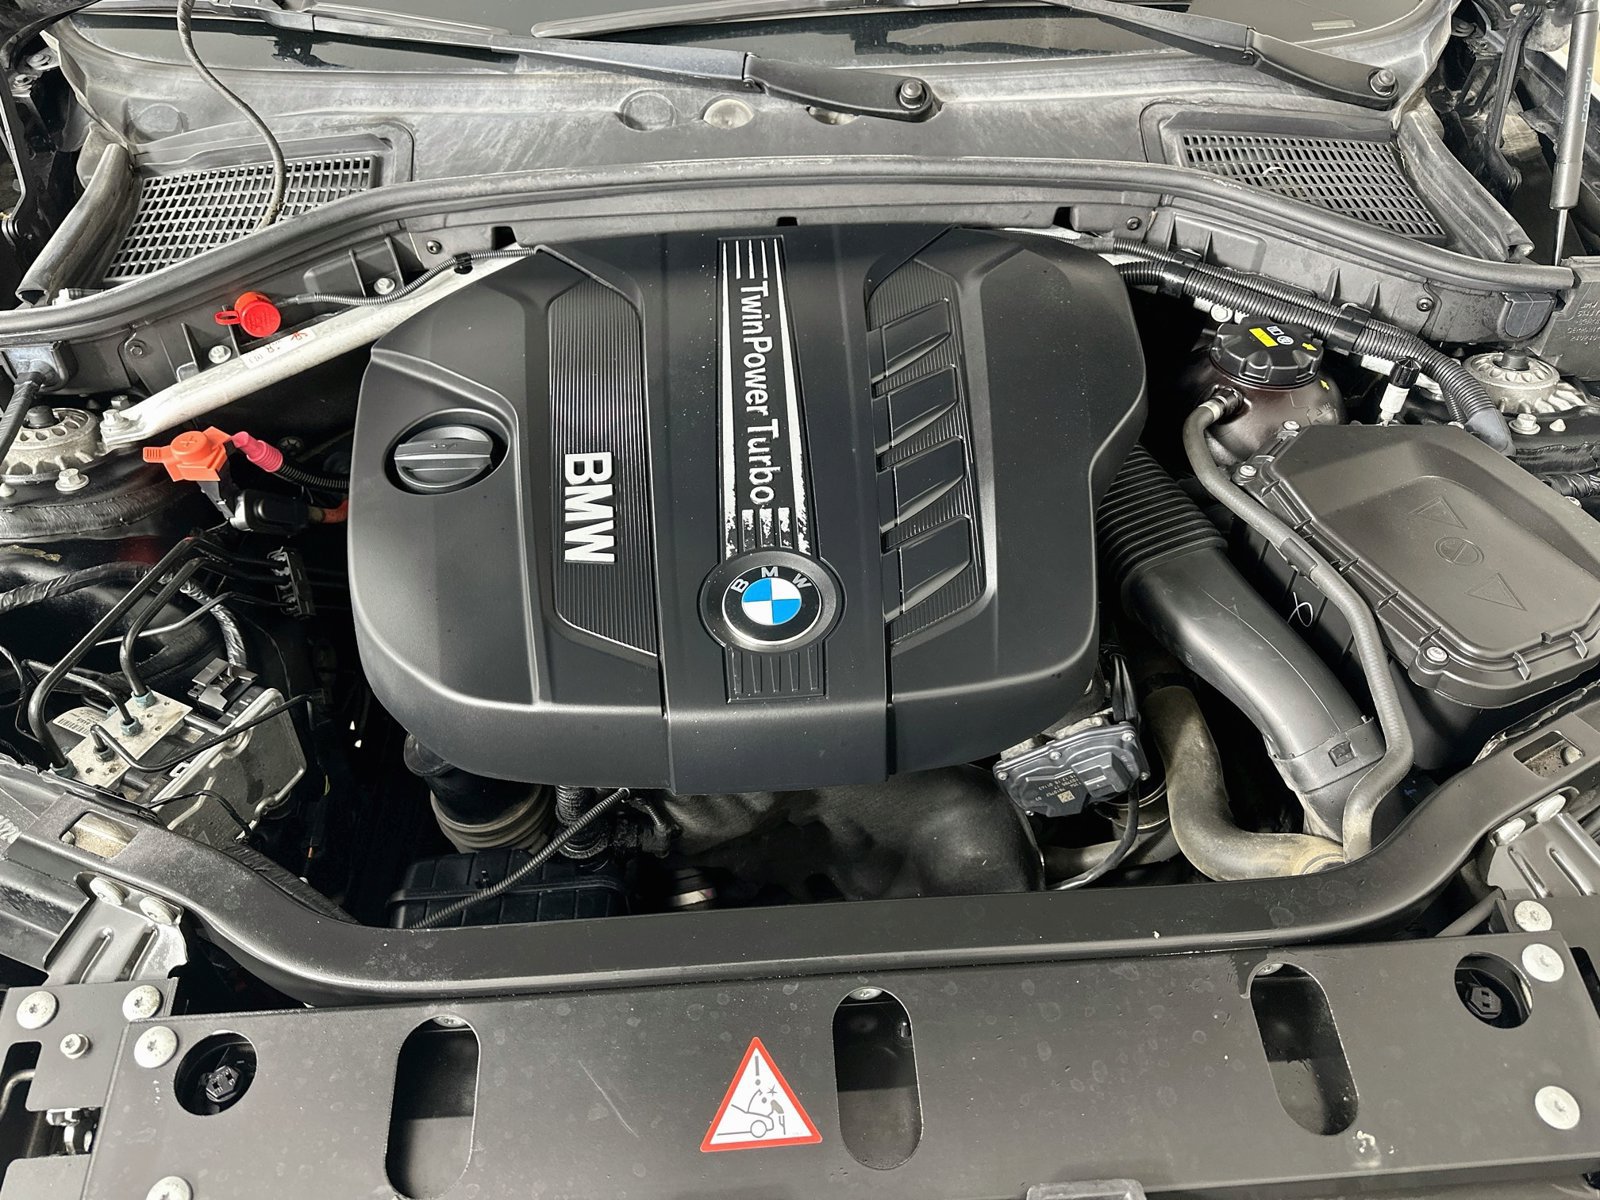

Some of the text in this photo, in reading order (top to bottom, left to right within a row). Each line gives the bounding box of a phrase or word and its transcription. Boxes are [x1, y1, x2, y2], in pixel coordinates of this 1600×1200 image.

[740, 280, 781, 505] TwinPower Turbo
[564, 451, 615, 563] BMW
[730, 566, 813, 594] BMW
